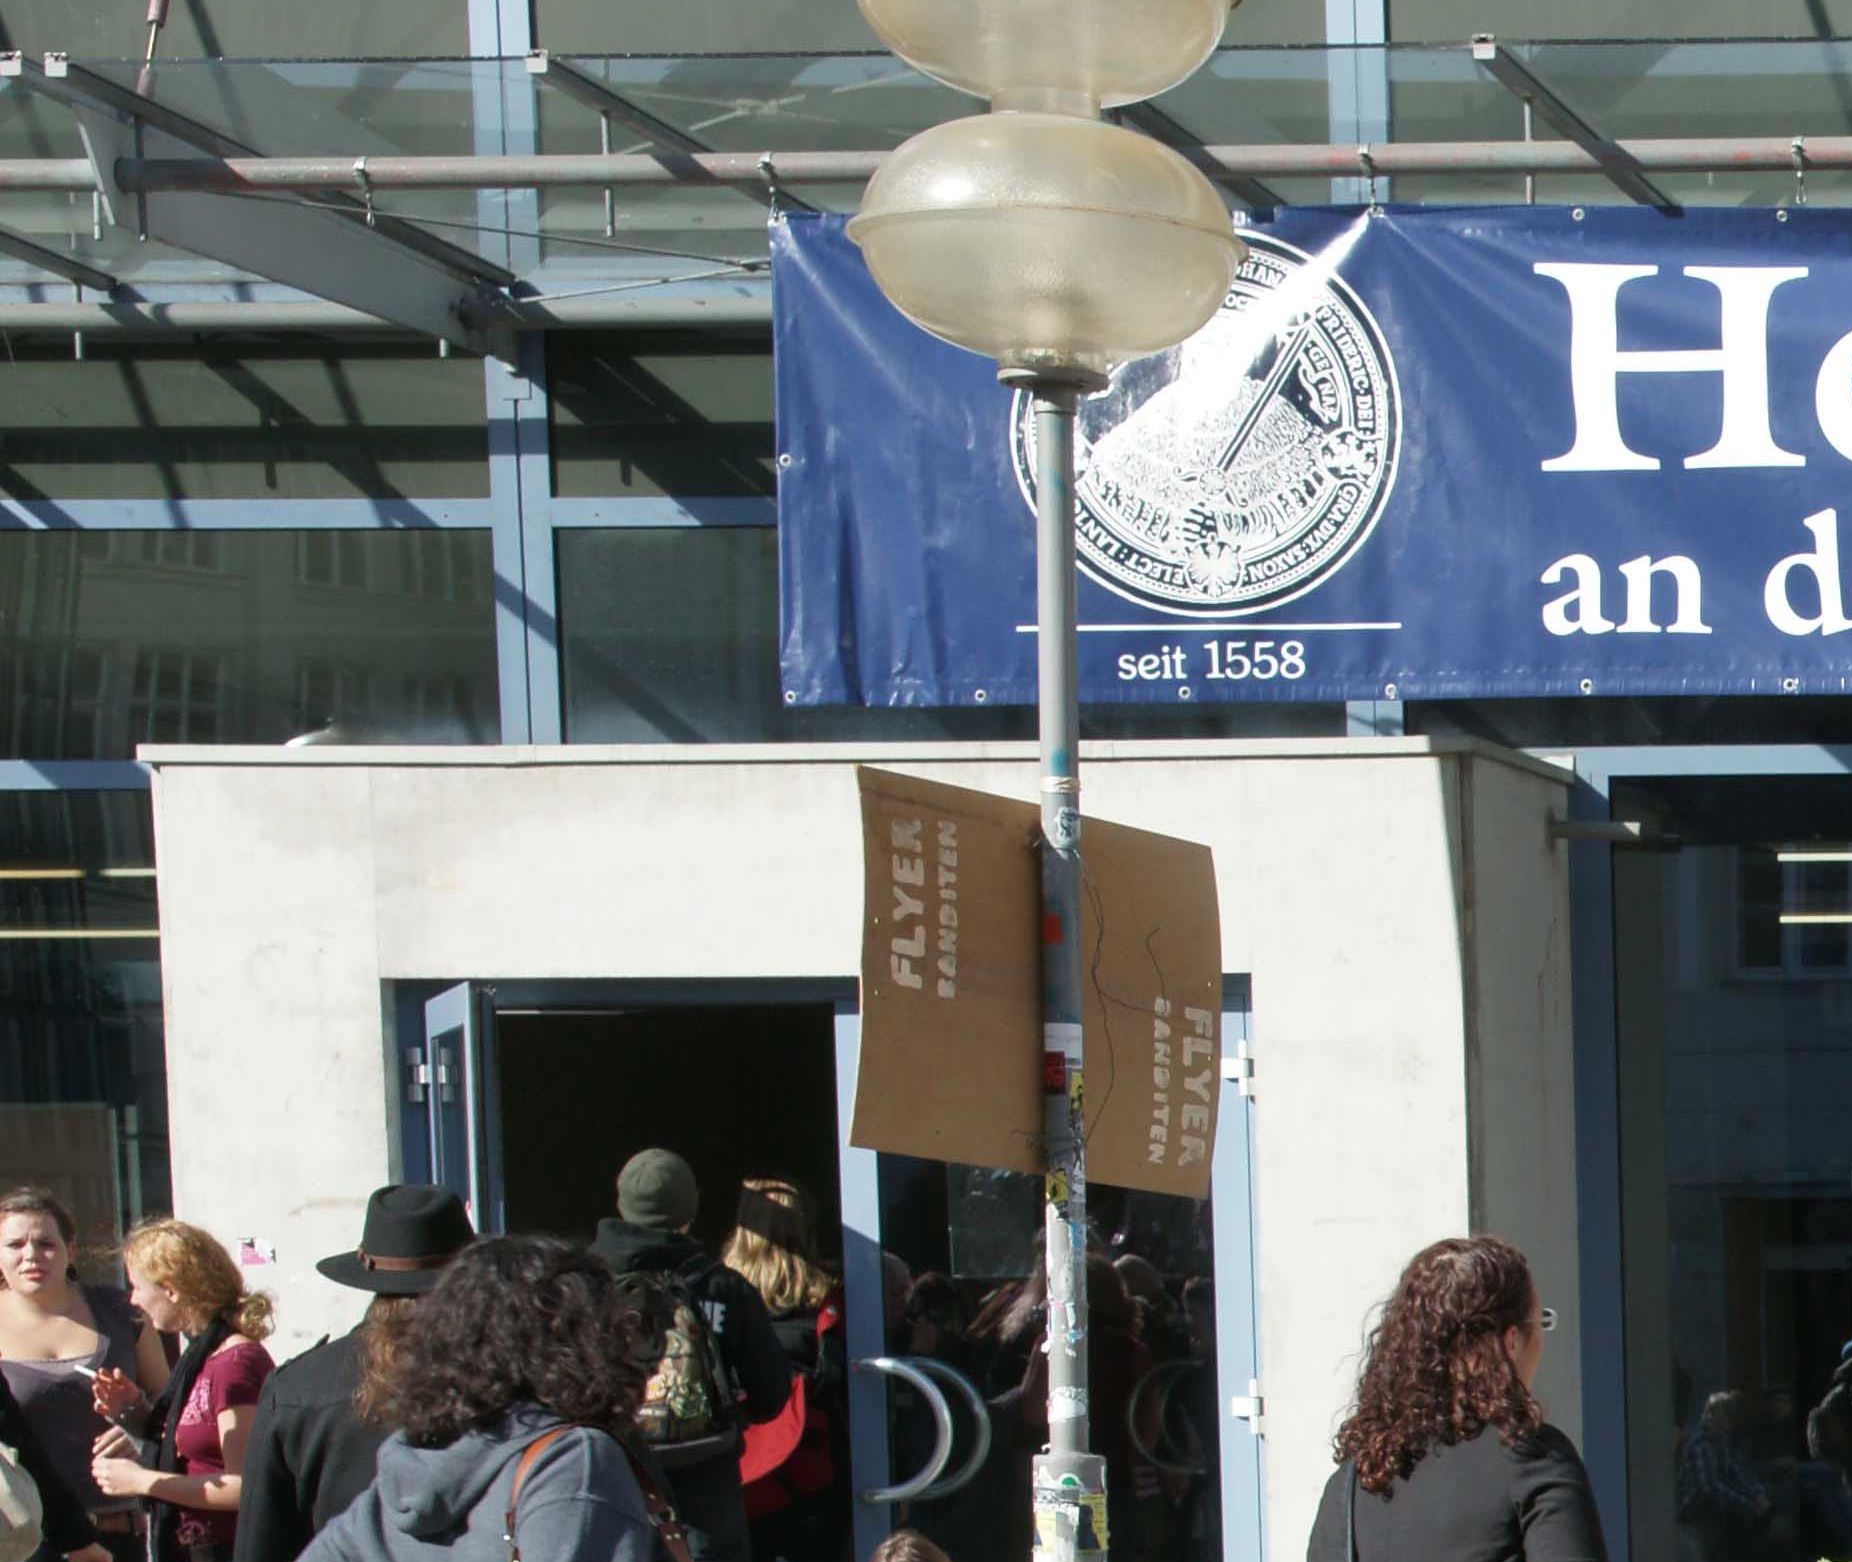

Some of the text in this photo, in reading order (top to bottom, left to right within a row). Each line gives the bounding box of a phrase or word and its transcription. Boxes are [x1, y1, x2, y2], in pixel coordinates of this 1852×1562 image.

[1541, 554, 1713, 636] an
[1117, 640, 1306, 680] seit 1558
[890, 818, 926, 989] FLYER
[1179, 1006, 1213, 1166] FLYER
